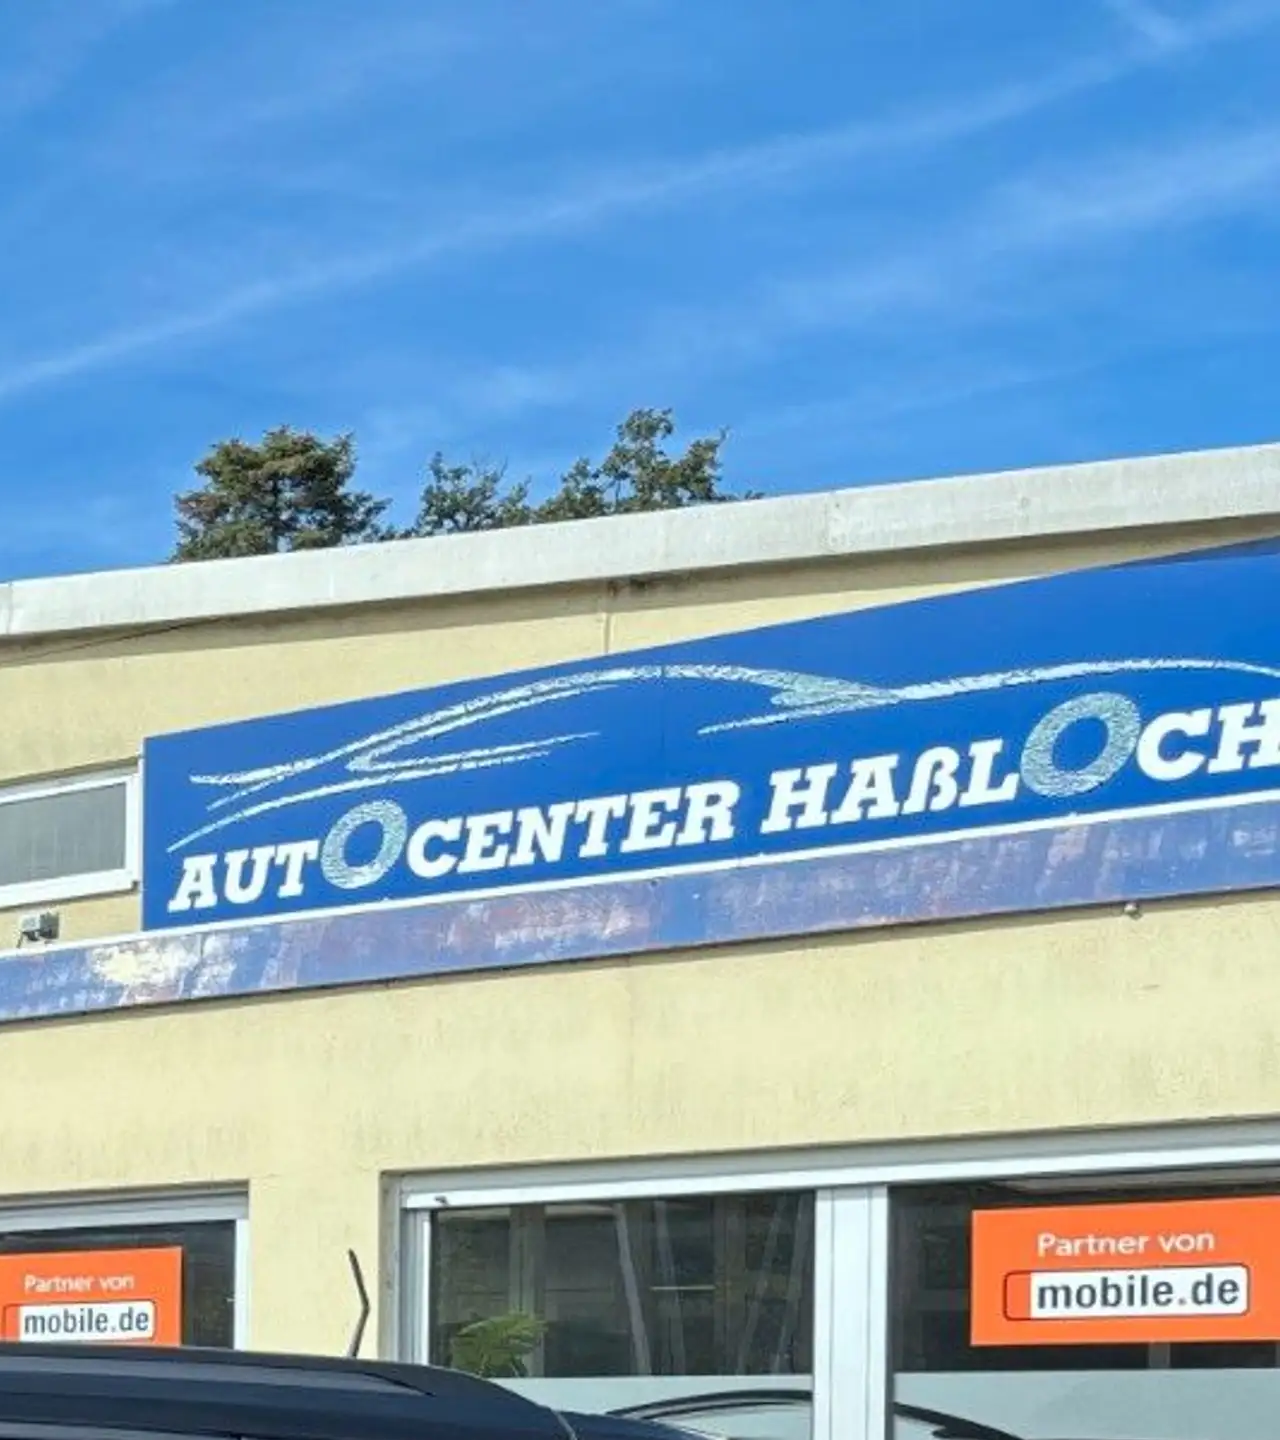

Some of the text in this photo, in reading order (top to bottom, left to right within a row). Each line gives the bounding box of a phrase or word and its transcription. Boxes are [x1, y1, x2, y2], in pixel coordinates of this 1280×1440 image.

[167, 691, 1280, 912] AUTOCENTER HAßLOCH
[1037, 1231, 1214, 1257] Partner von
[24, 1274, 135, 1294] Partner von
[1037, 1272, 1240, 1309] mobile.de
[24, 1307, 149, 1334] mobile.de
